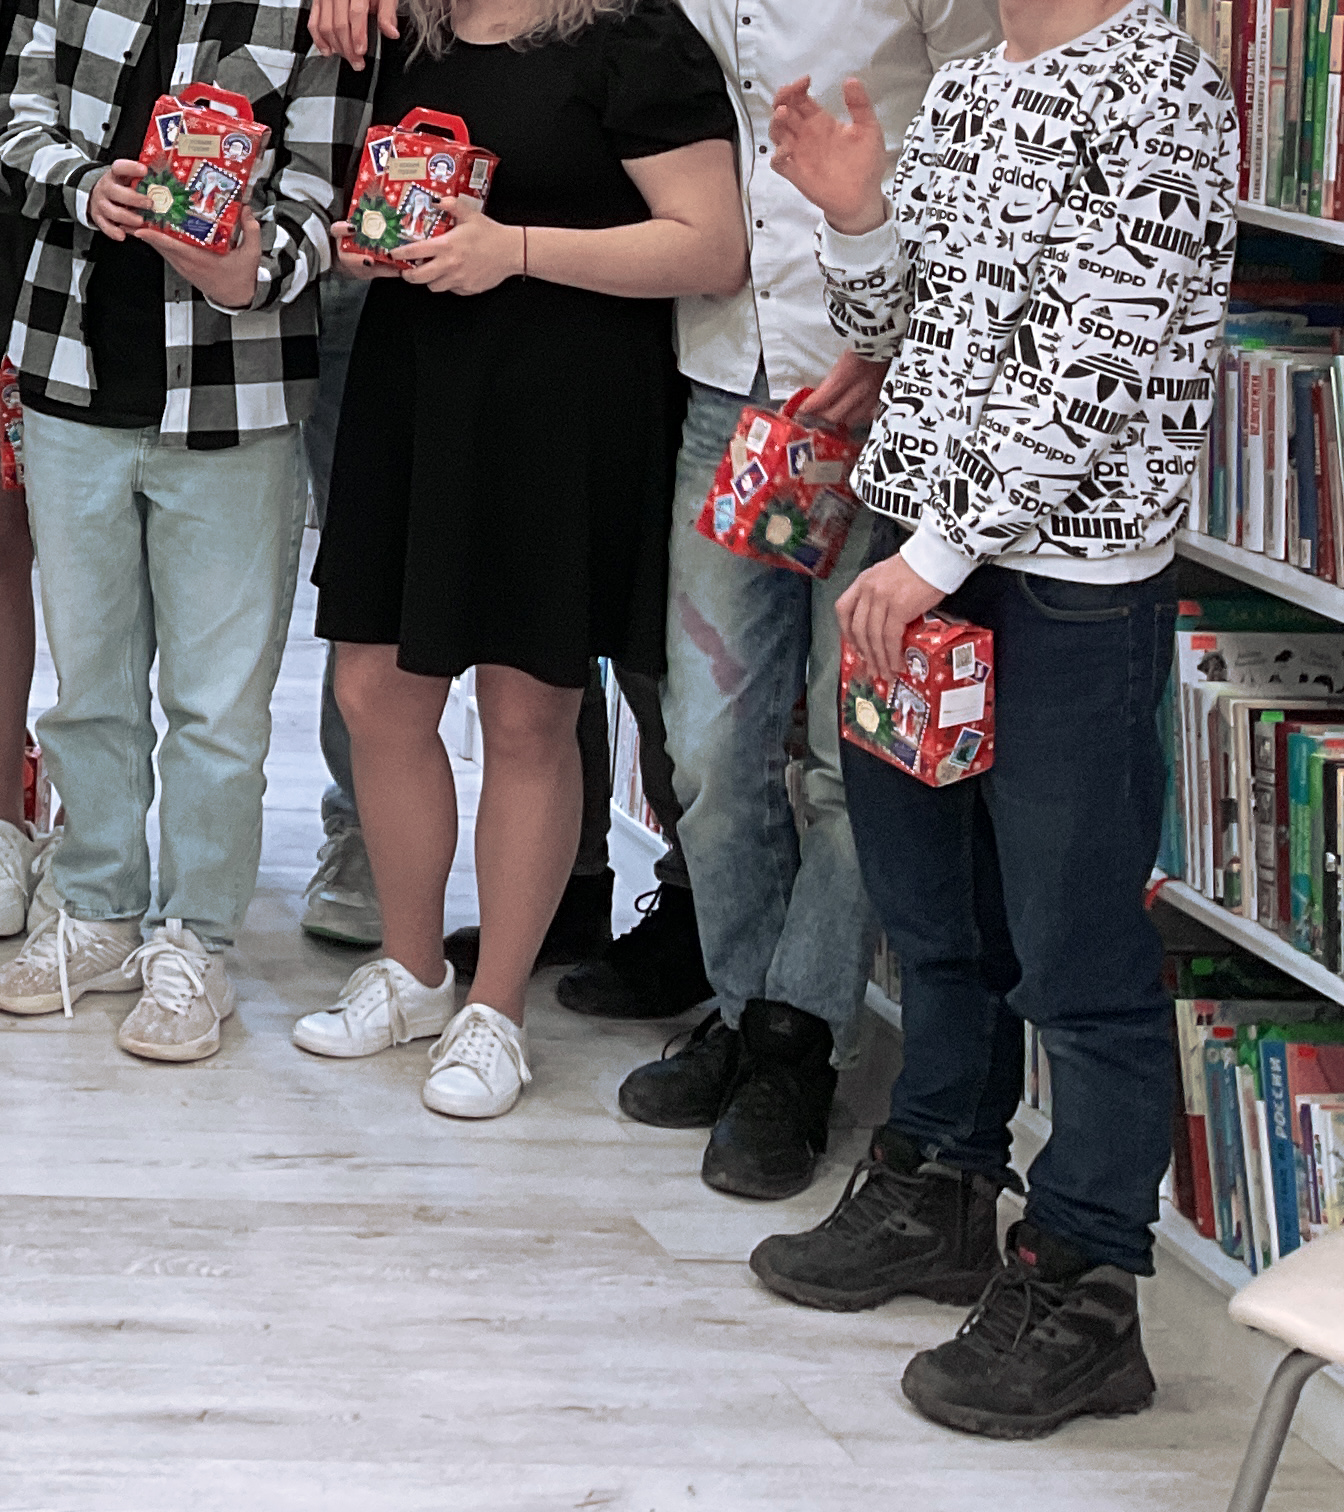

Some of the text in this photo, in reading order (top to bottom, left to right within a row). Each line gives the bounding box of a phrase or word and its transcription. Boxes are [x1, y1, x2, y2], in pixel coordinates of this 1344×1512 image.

[1012, 87, 1074, 119] PUMA
[1078, 257, 1146, 288] adidas
[1146, 376, 1210, 401] PUMA
[1012, 431, 1076, 465] adidas
[1051, 514, 1141, 540] PUMA
